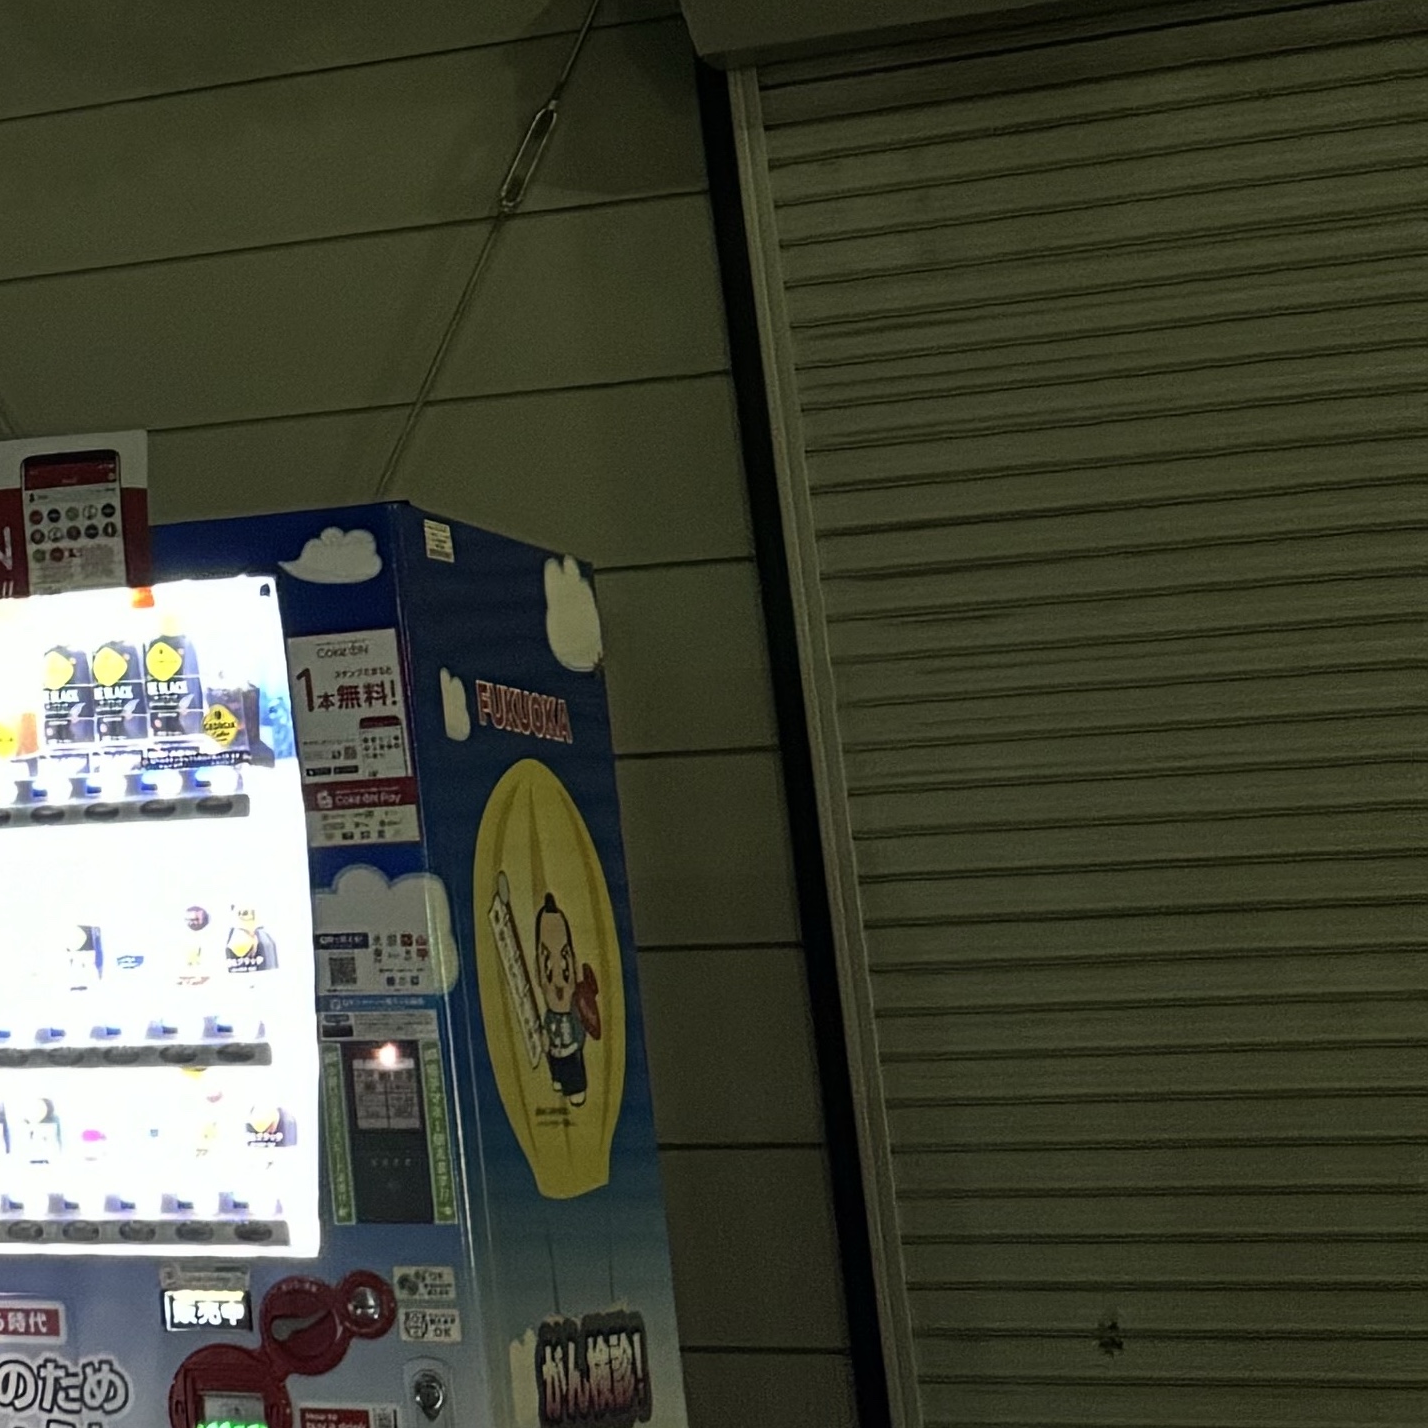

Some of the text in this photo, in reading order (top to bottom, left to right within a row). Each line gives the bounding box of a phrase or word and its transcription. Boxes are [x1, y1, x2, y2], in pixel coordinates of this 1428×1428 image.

[296, 667, 397, 712] 1本無料!
[476, 680, 573, 744] FUKUOKA
[542, 1332, 645, 1420] がん検診!
